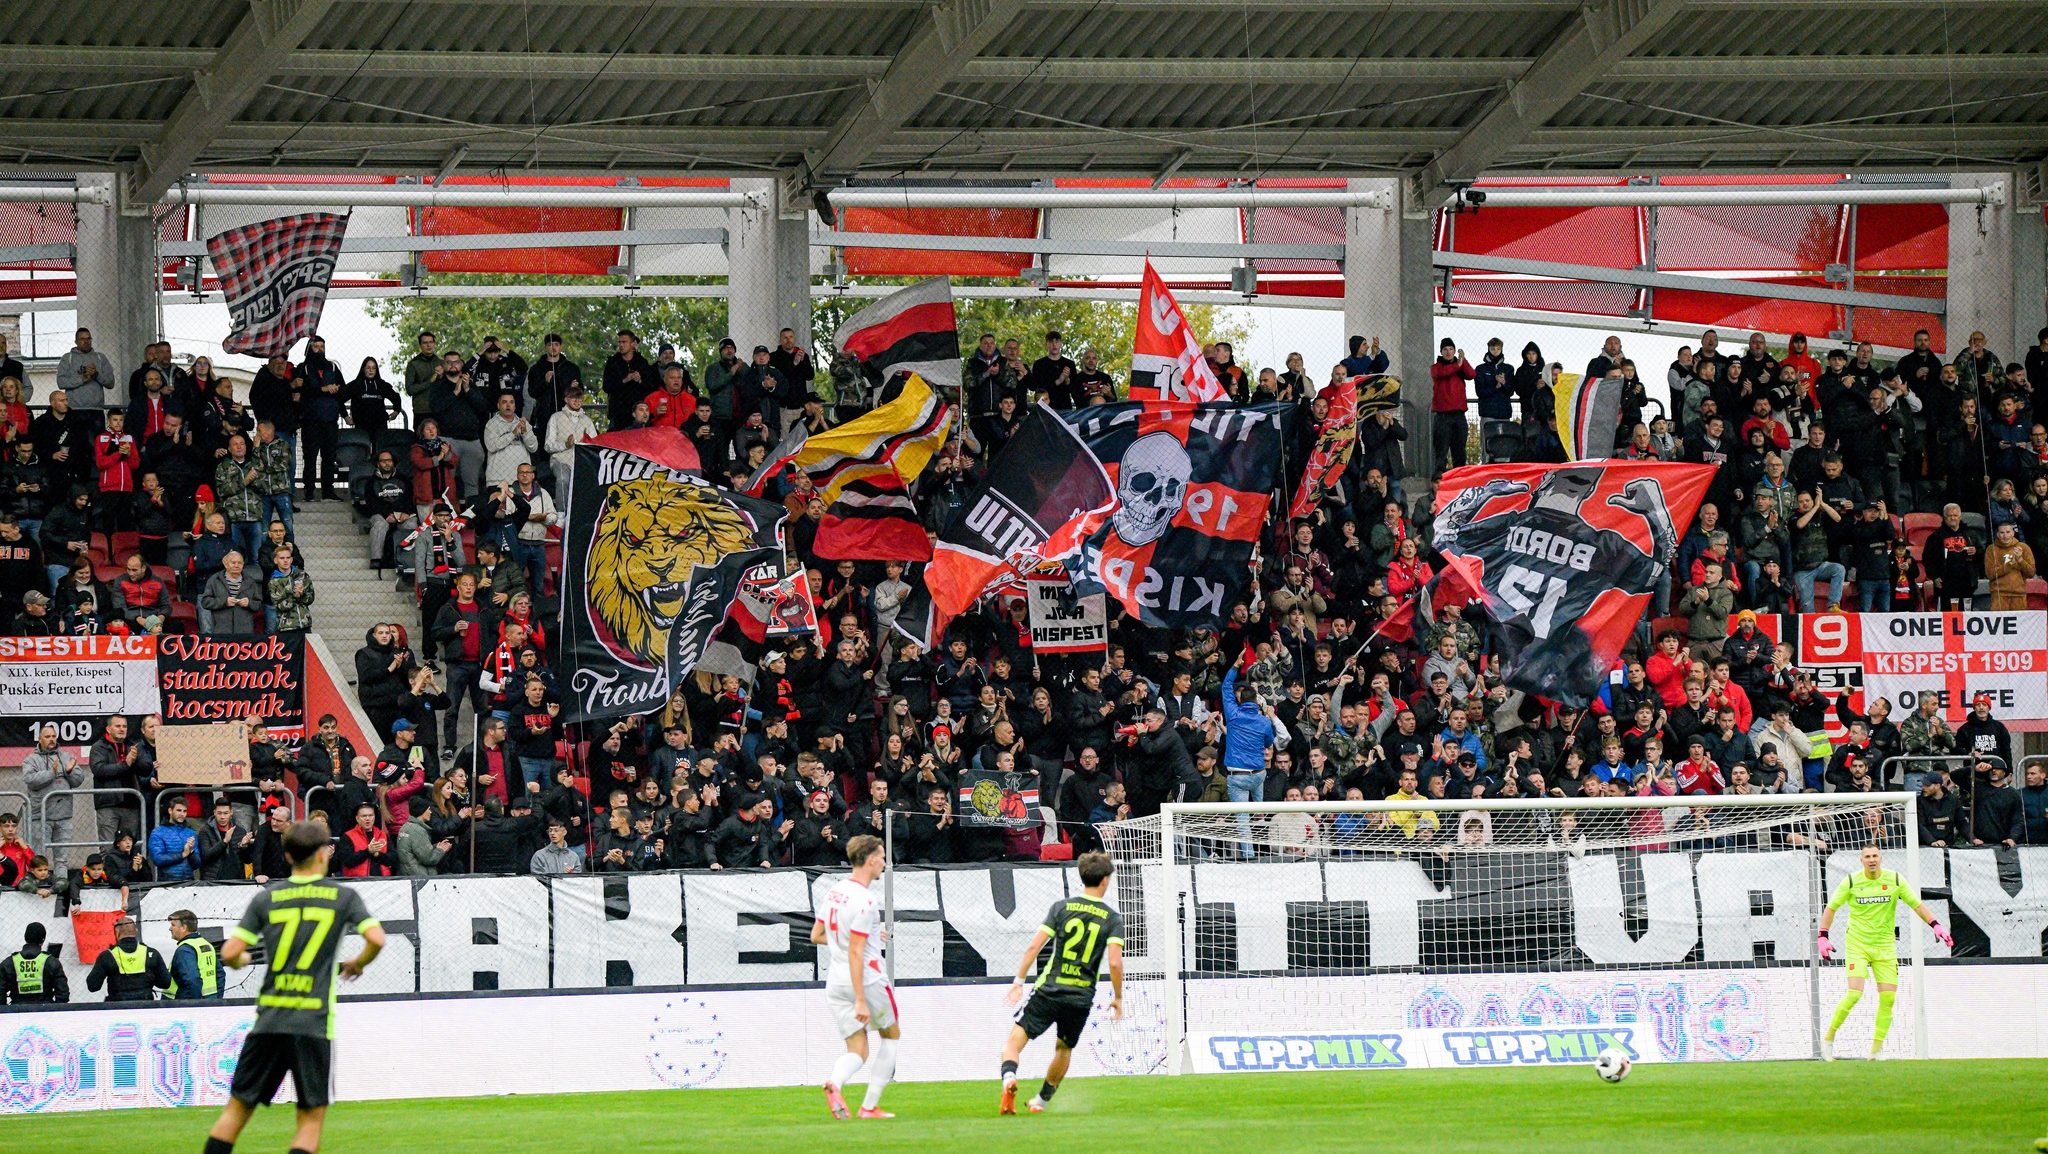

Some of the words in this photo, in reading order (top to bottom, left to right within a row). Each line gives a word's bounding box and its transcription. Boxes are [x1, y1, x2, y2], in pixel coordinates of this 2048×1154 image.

[1889, 618, 1943, 637] ONE
[1952, 617, 2018, 635] LOVE
[0, 636, 100, 657] SPESTI
[106, 635, 152, 656] AC.
[8, 667, 32, 678] XIX.
[34, 666, 73, 679] kerület,
[76, 666, 112, 679] Kispest
[1876, 652, 1973, 673] KISPEST
[1980, 652, 2033, 672] 1909
[163, 664, 297, 690] stadionok,
[48, 683, 92, 695] Ferenc
[96, 684, 123, 695] utca
[1898, 690, 1951, 710] OE
[268, 906, 336, 972] 77
[1062, 917, 1100, 964] 21
